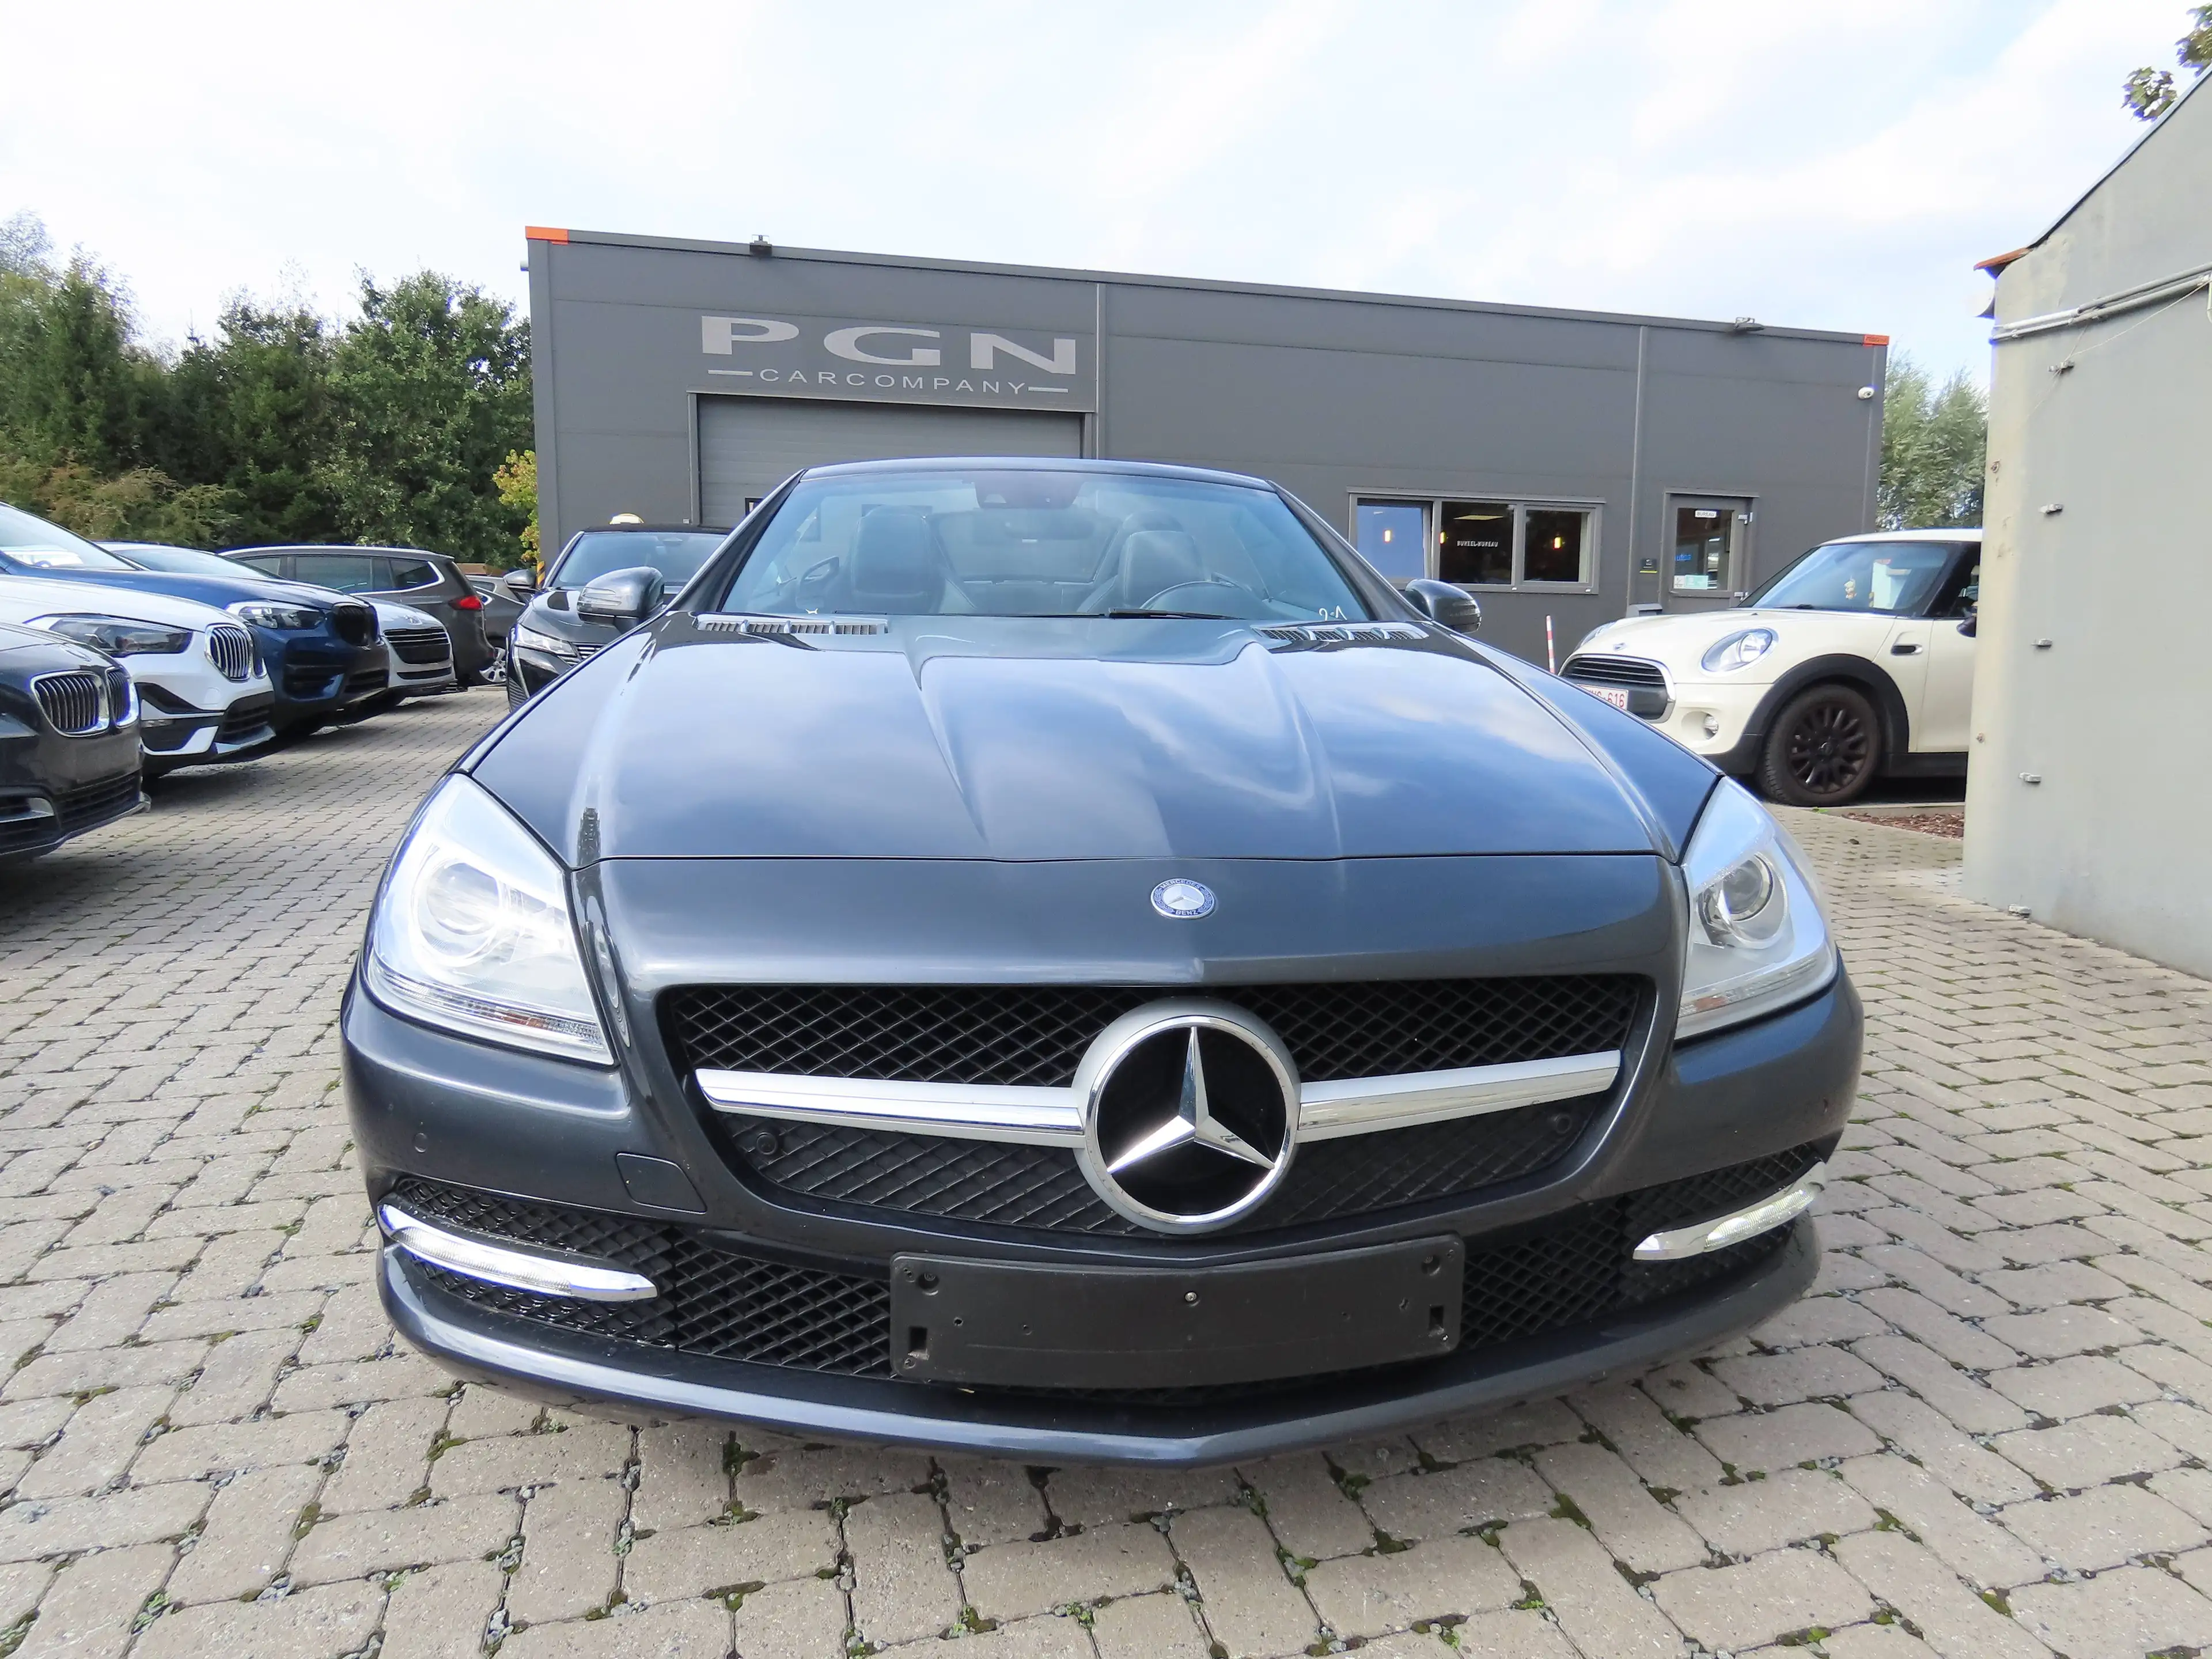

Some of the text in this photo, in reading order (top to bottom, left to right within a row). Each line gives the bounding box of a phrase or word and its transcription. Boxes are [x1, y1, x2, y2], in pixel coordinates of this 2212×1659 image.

[702, 315, 1075, 374] PGN
[760, 369, 1025, 394] CARCOMPANY
[1160, 879, 1202, 889] MERCEDES
